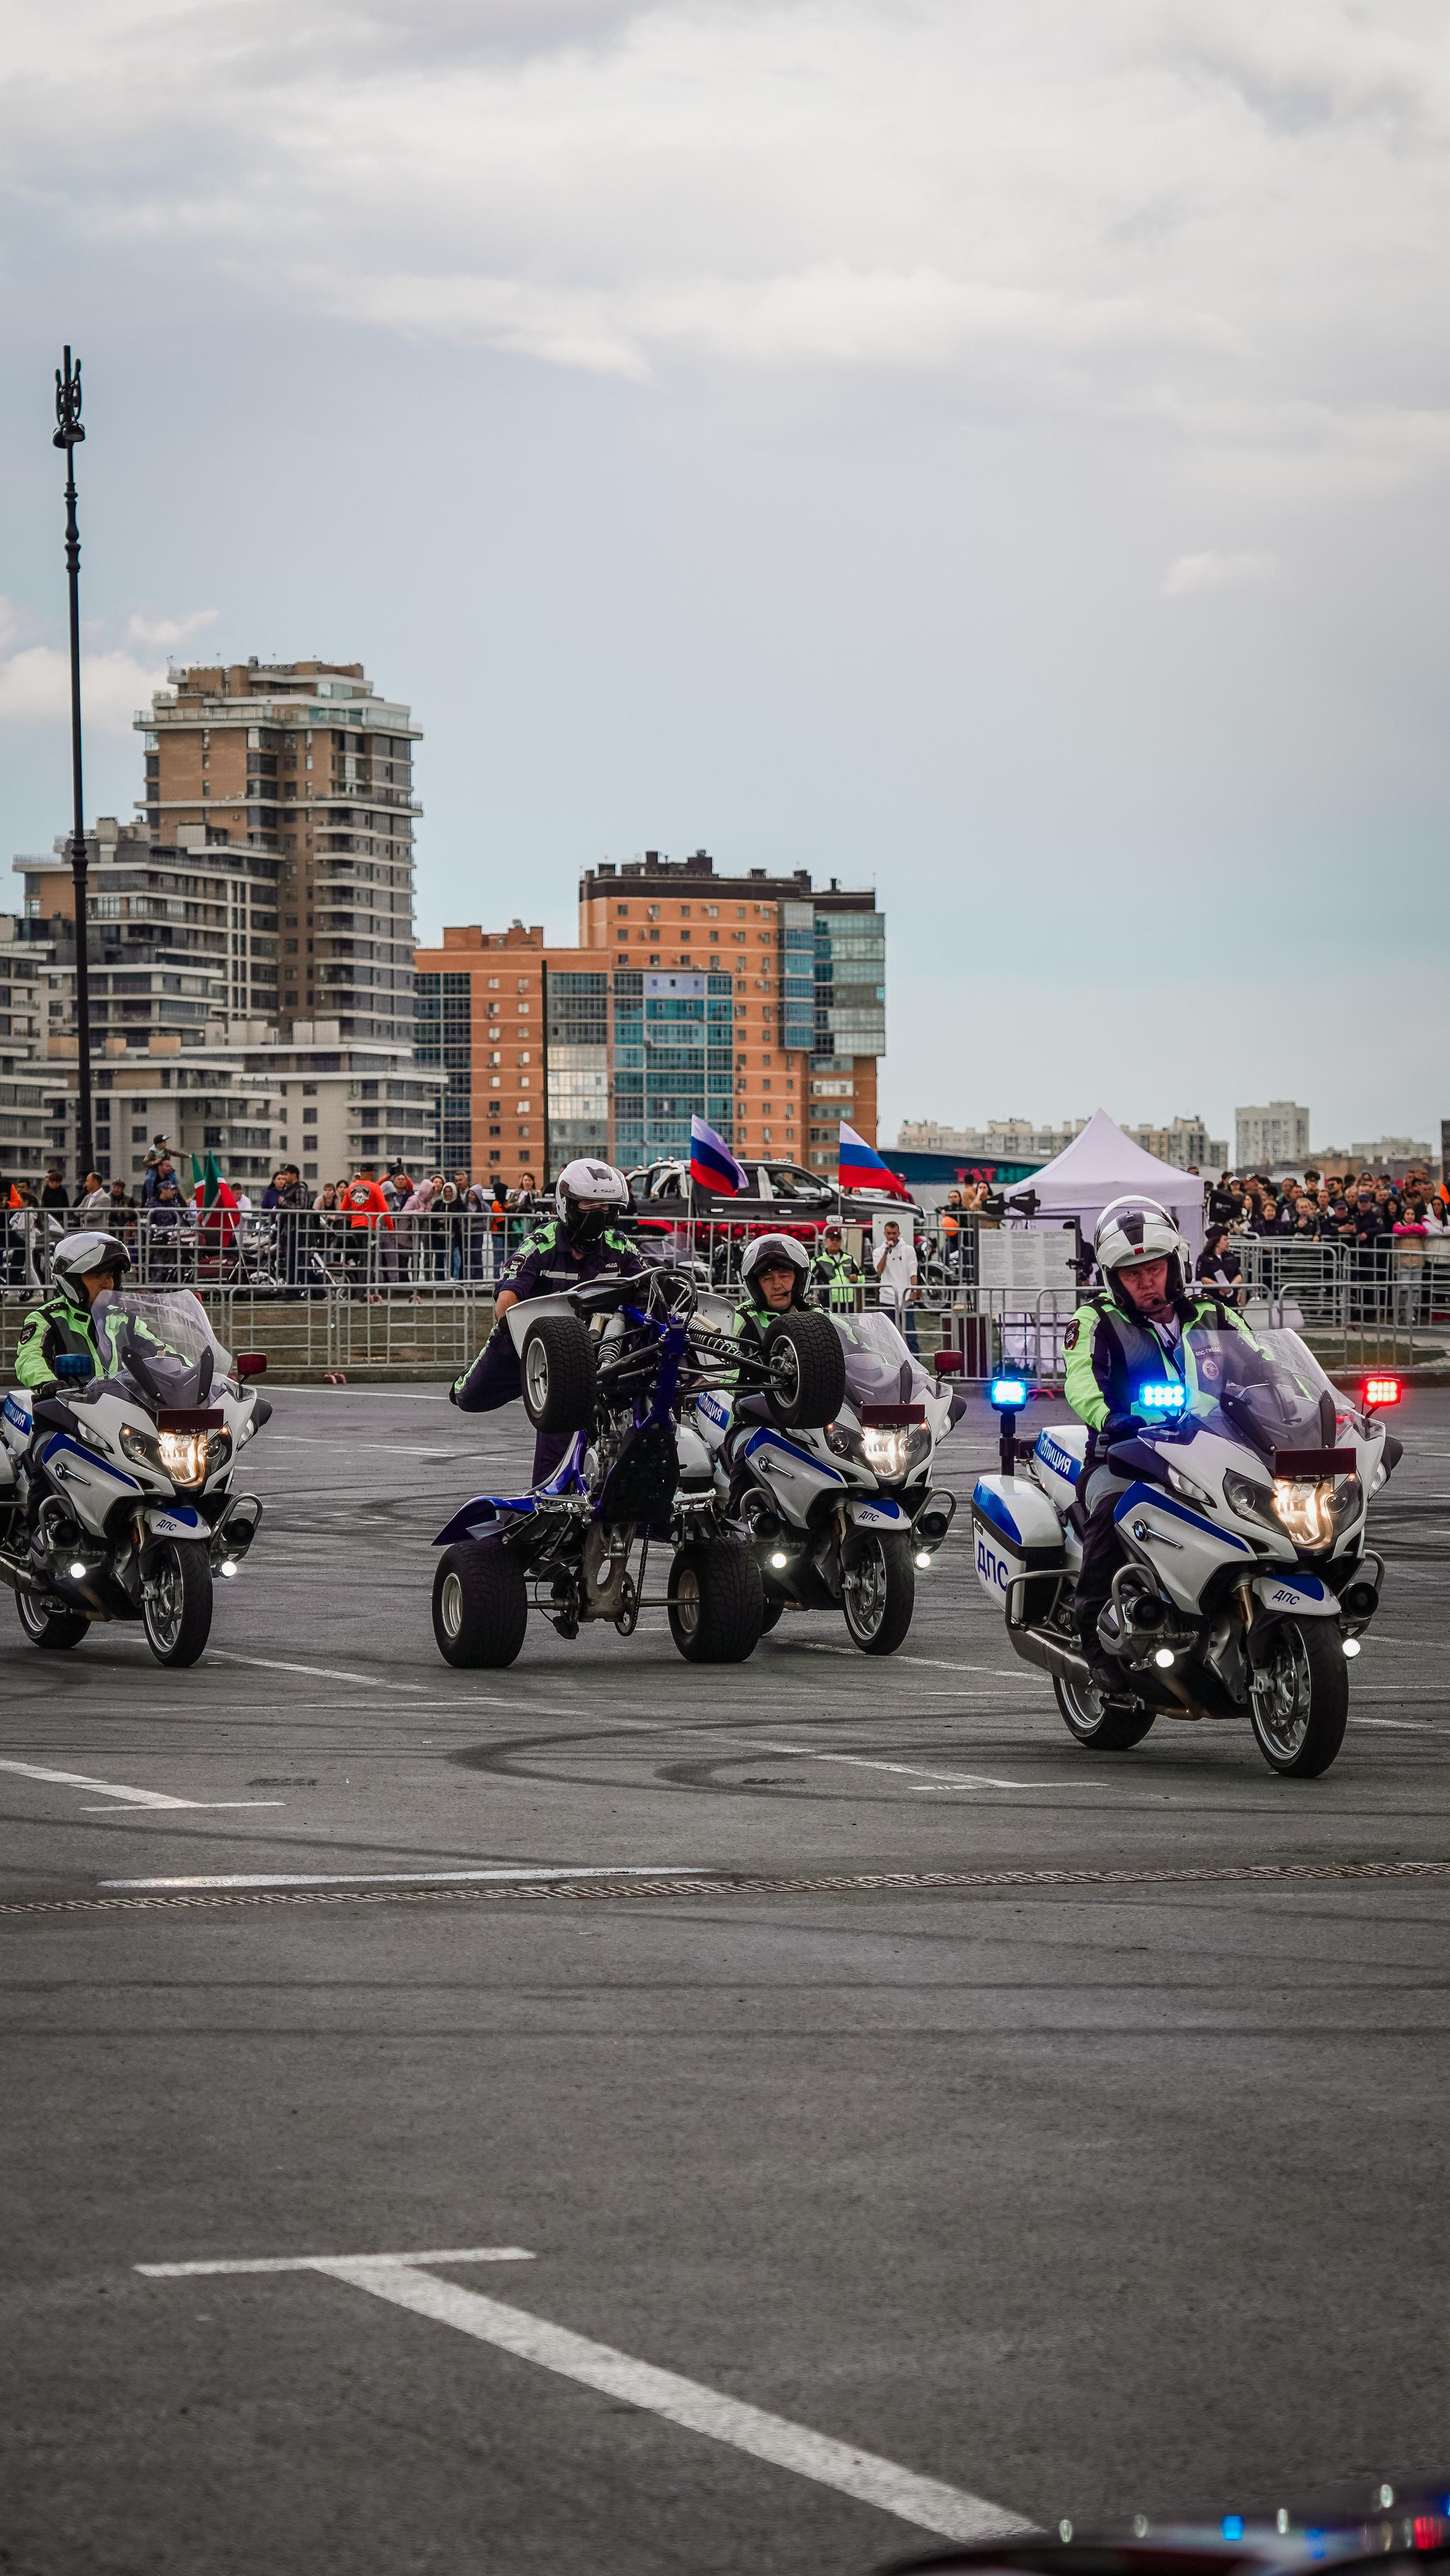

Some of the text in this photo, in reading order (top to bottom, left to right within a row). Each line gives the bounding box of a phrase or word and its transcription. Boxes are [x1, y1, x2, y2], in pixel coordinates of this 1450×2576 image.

[953, 1167, 1040, 1184] ТАТНЕ
[6, 1402, 26, 1427] ОЛИЦИЯ
[1038, 1437, 1071, 1475] ПОЛИЦИЯ
[858, 1511, 880, 1521] ДПС
[156, 1519, 177, 1531] ДПС
[977, 1540, 1009, 1592] ДПС
[1272, 1589, 1300, 1605] ДПС
